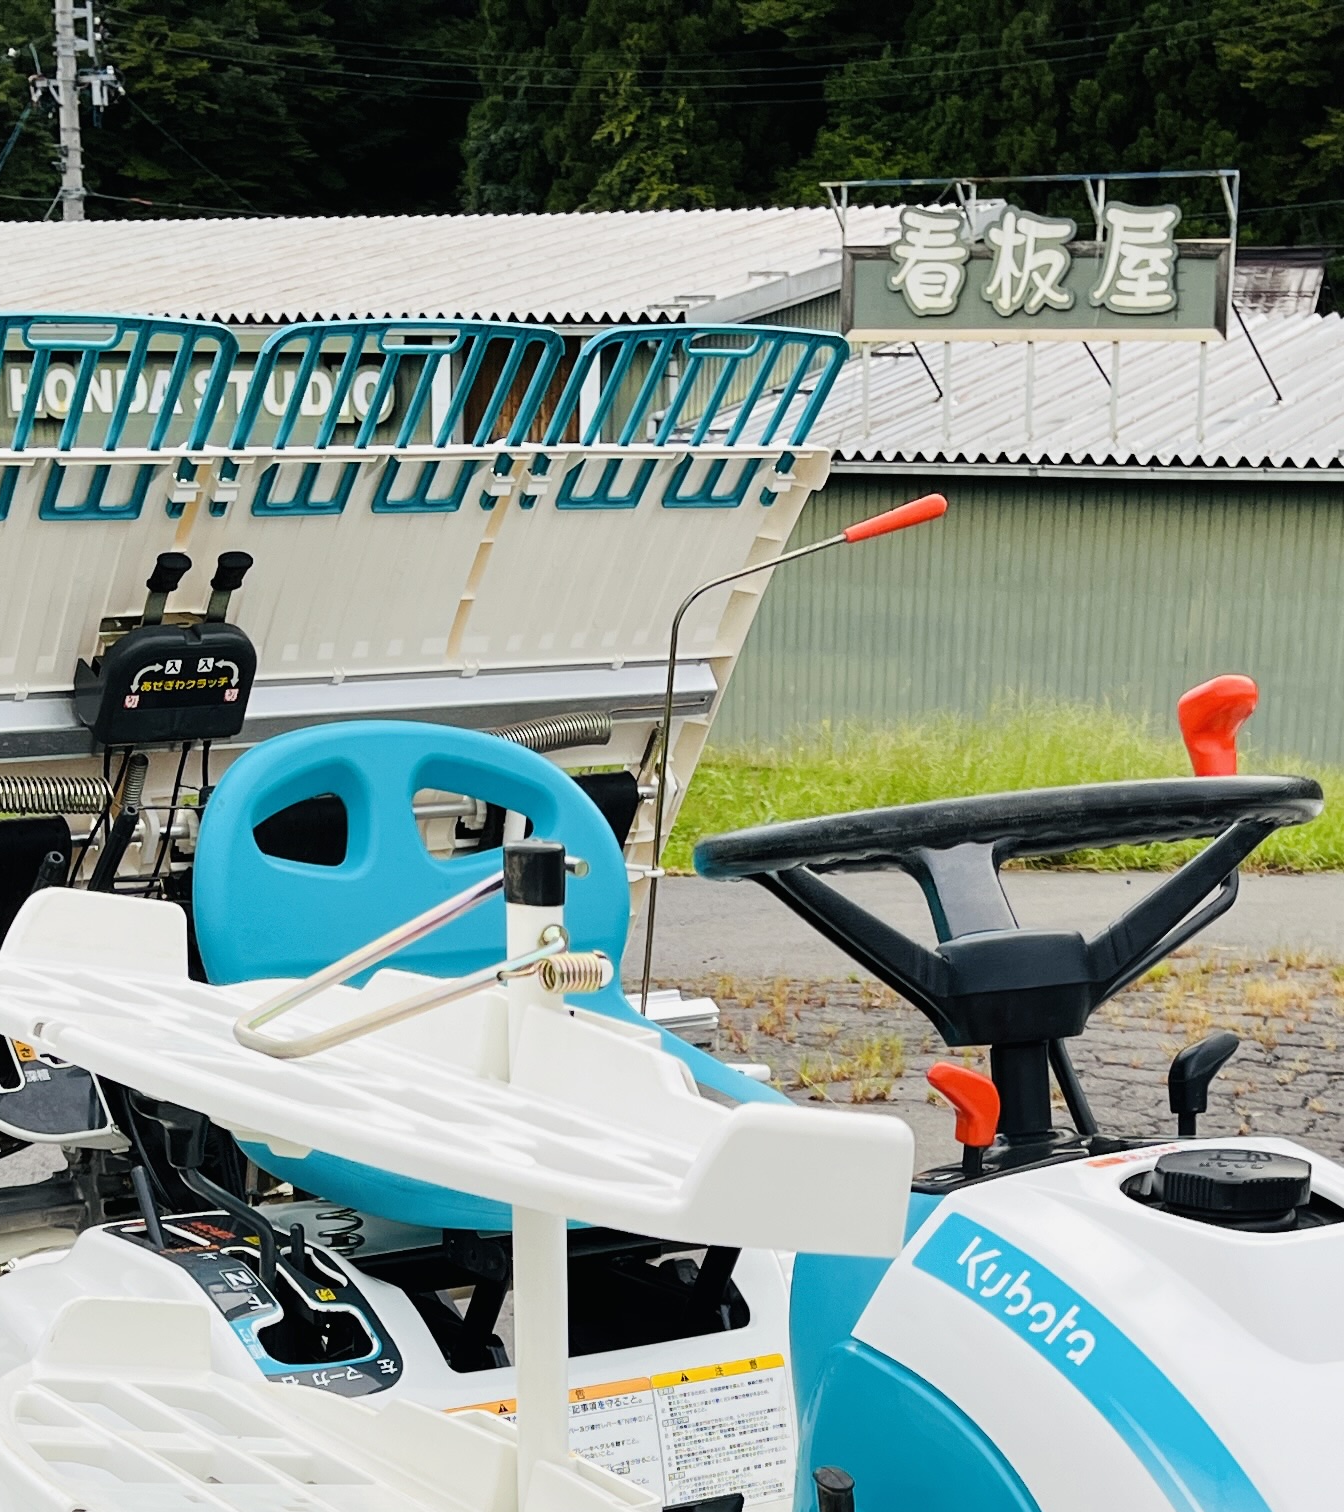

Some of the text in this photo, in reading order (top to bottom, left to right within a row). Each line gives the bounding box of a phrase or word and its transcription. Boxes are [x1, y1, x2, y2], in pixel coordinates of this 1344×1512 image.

[891, 203, 1181, 314] 看板屋
[10, 368, 183, 414] HONDA
[140, 676, 229, 692] あぜぎわクラッチ
[957, 1236, 1096, 1366] Kubota
[570, 1396, 643, 1414] 記事項を守ること。
